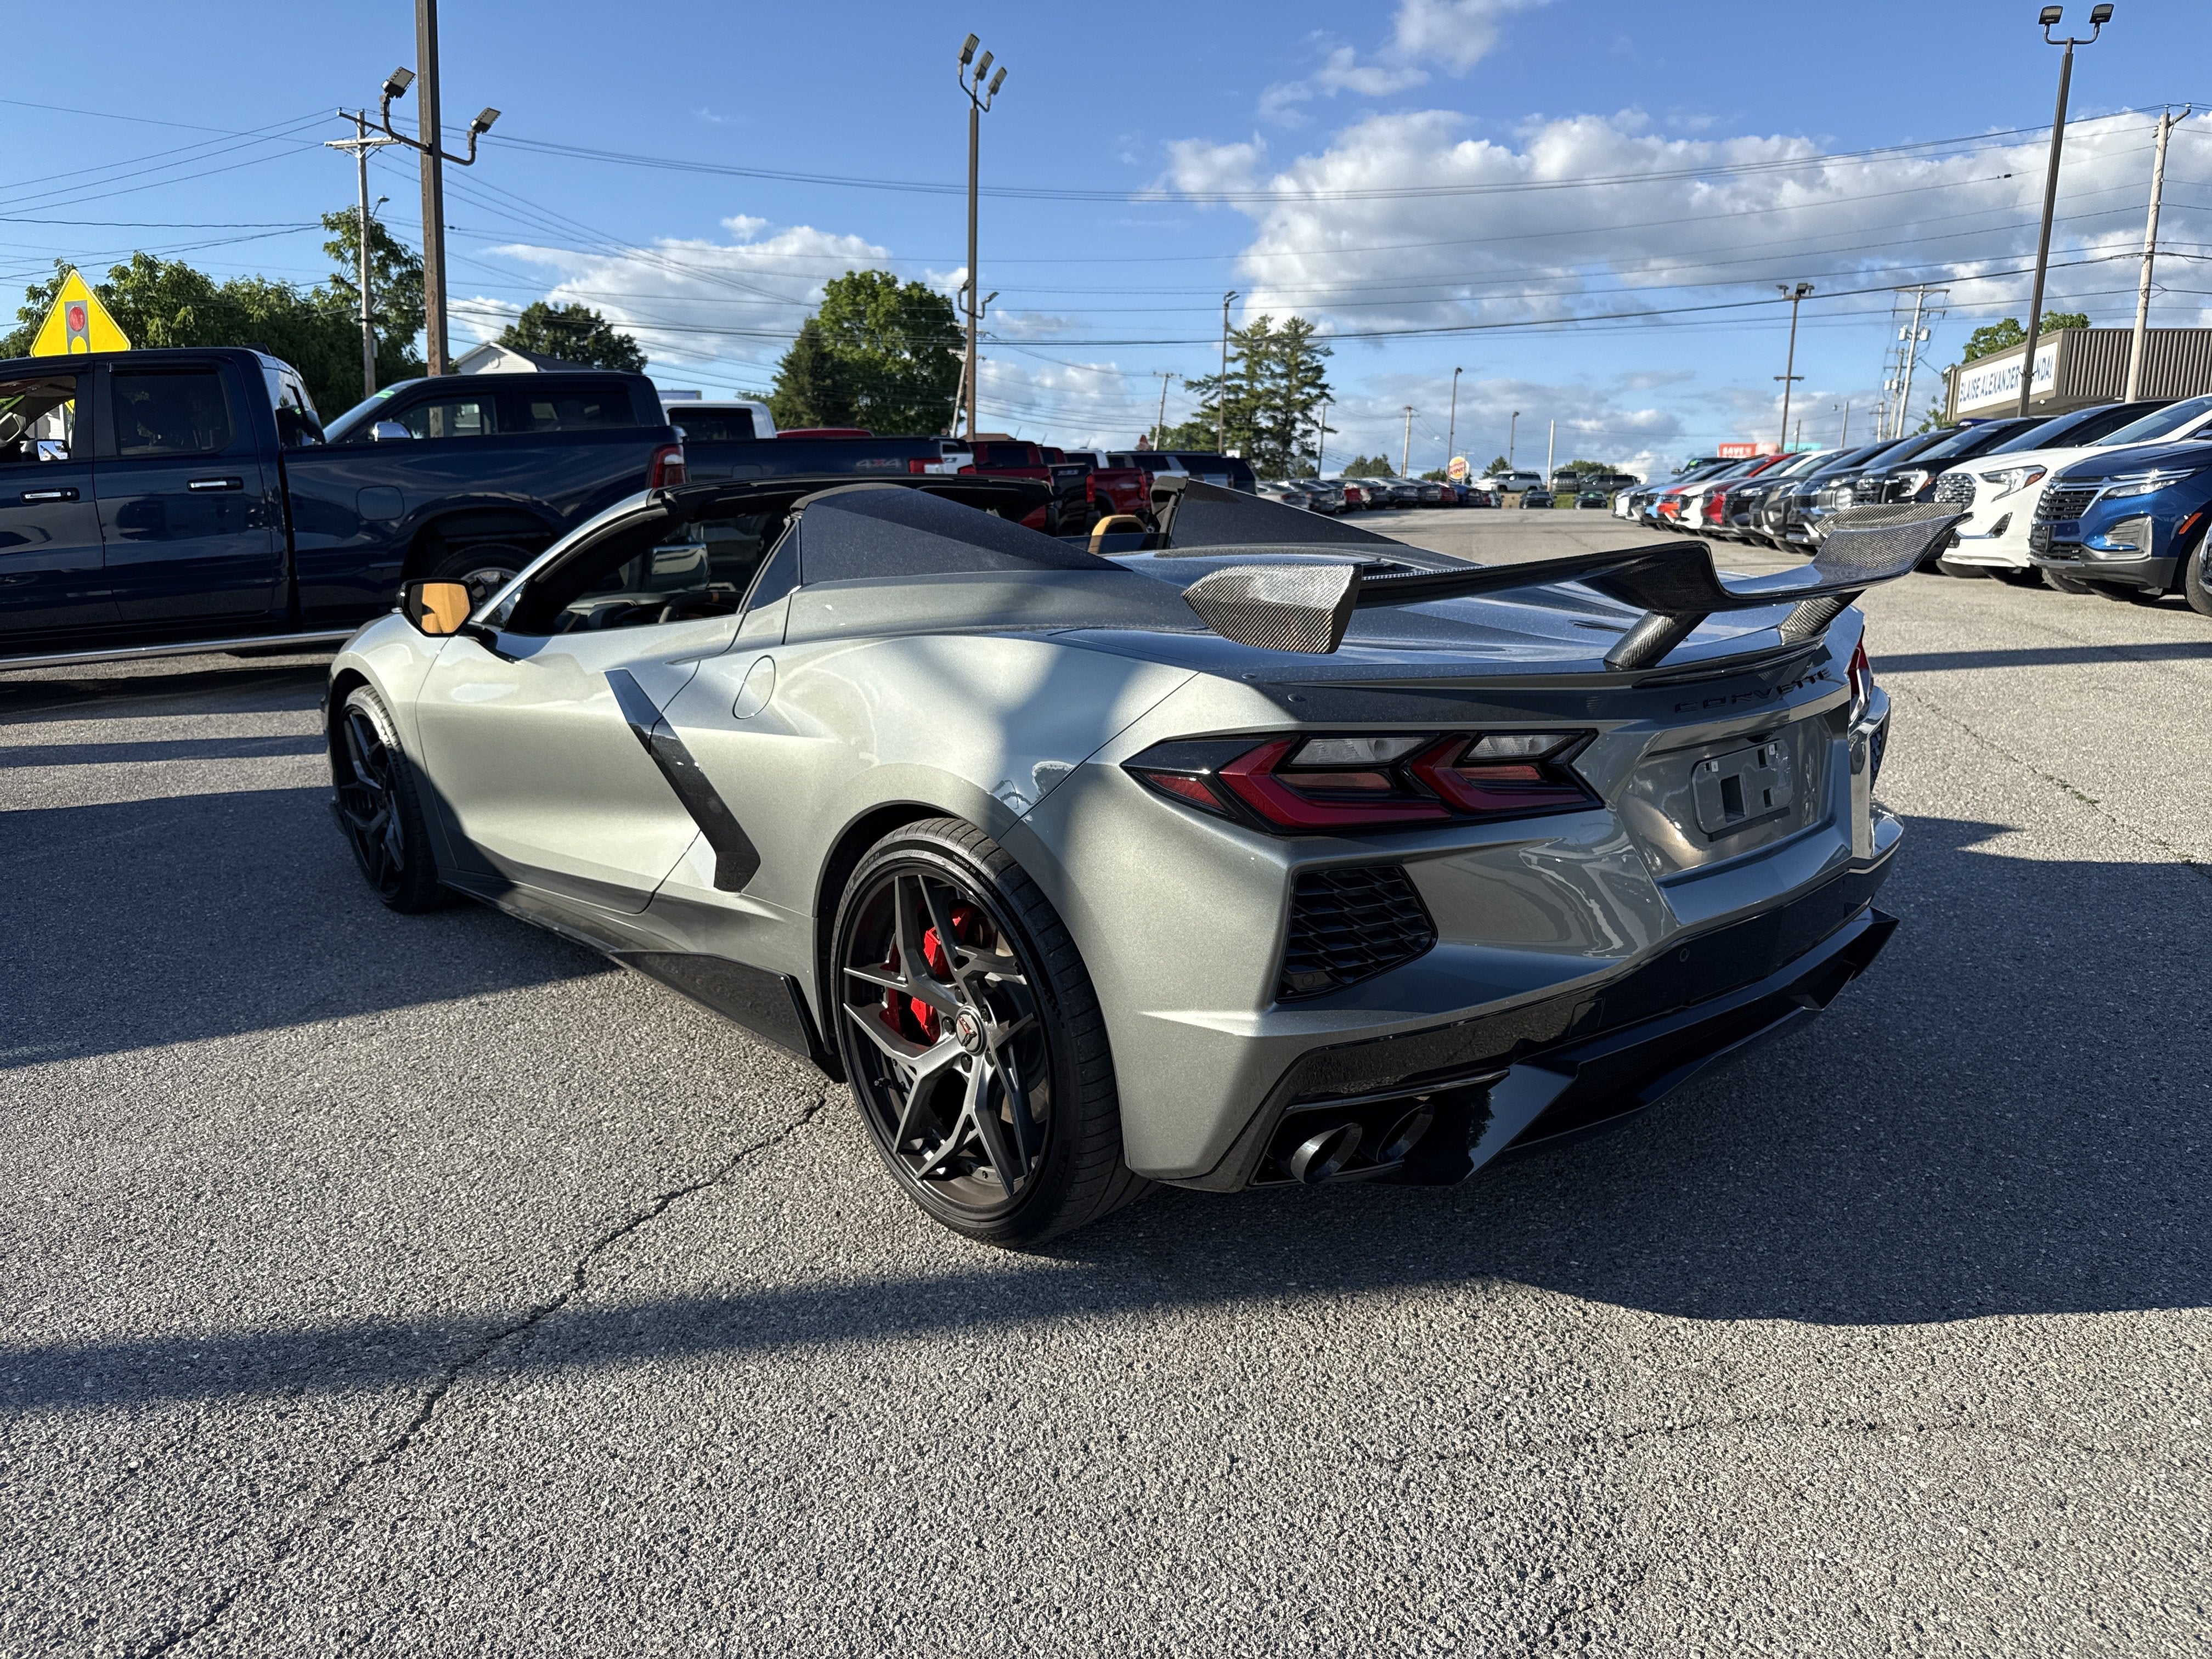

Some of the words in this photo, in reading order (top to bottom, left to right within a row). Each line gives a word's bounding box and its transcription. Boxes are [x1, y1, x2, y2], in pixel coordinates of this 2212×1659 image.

[1960, 377, 1980, 403] BLAISE
[1980, 365, 2020, 398] ALEXANDER
[1722, 447, 1743, 456] SAVE
[1674, 667, 1832, 713] CORVETTE
[952, 854, 970, 869] TREADWEAR
